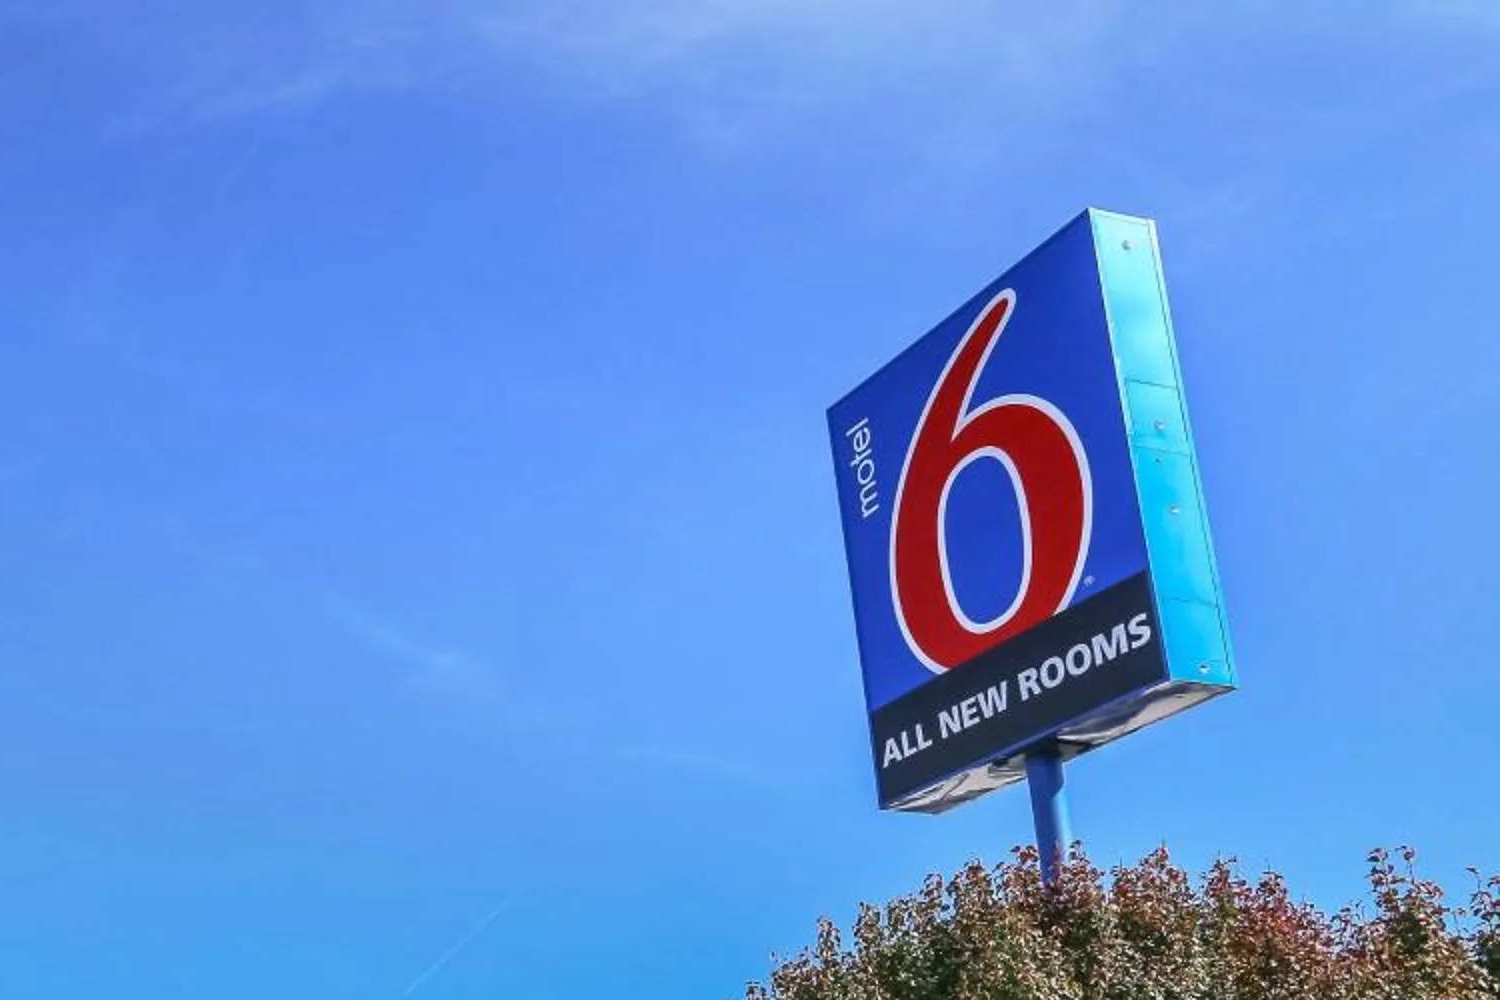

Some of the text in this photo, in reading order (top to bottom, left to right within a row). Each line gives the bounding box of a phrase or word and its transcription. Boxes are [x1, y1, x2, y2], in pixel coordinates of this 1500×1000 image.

[845, 417, 879, 518] motel
[889, 287, 1092, 675] 6
[882, 612, 1152, 769] ALL NEW ROOMS
